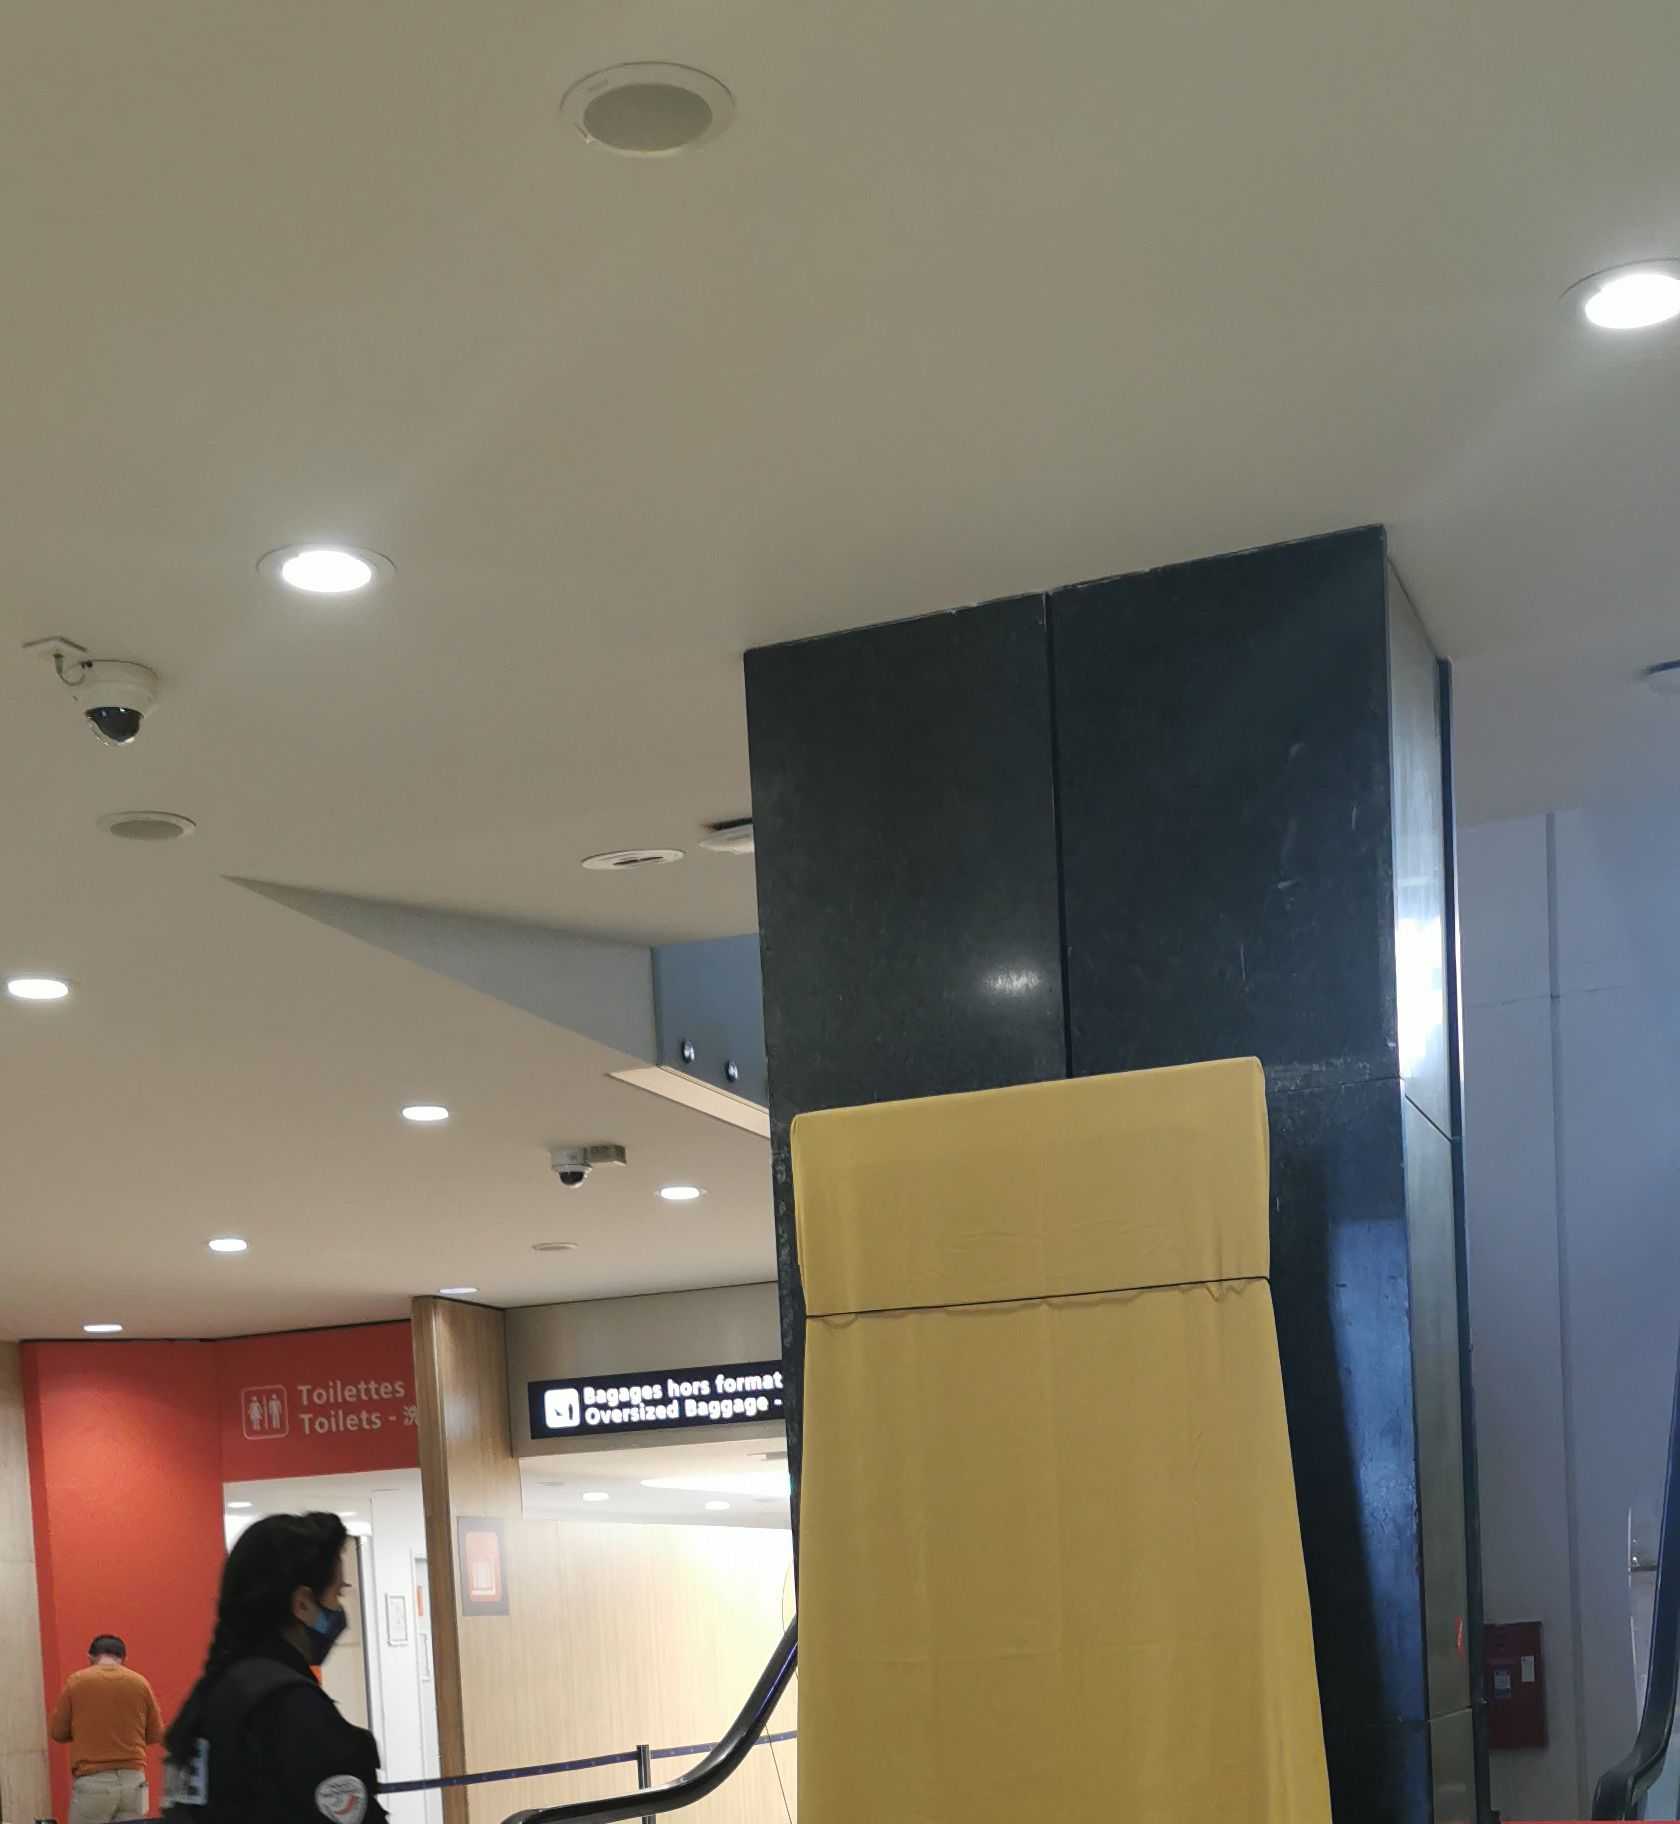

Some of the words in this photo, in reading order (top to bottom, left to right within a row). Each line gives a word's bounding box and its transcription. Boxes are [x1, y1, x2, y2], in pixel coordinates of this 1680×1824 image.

[297, 1380, 405, 1406] Toilettes
[583, 1383, 663, 1407] Bagages
[667, 1378, 710, 1398] hors
[715, 1371, 783, 1394] format
[299, 1409, 382, 1435] Toilets
[584, 1400, 679, 1425] Oversized
[685, 1396, 769, 1420] Baggage
